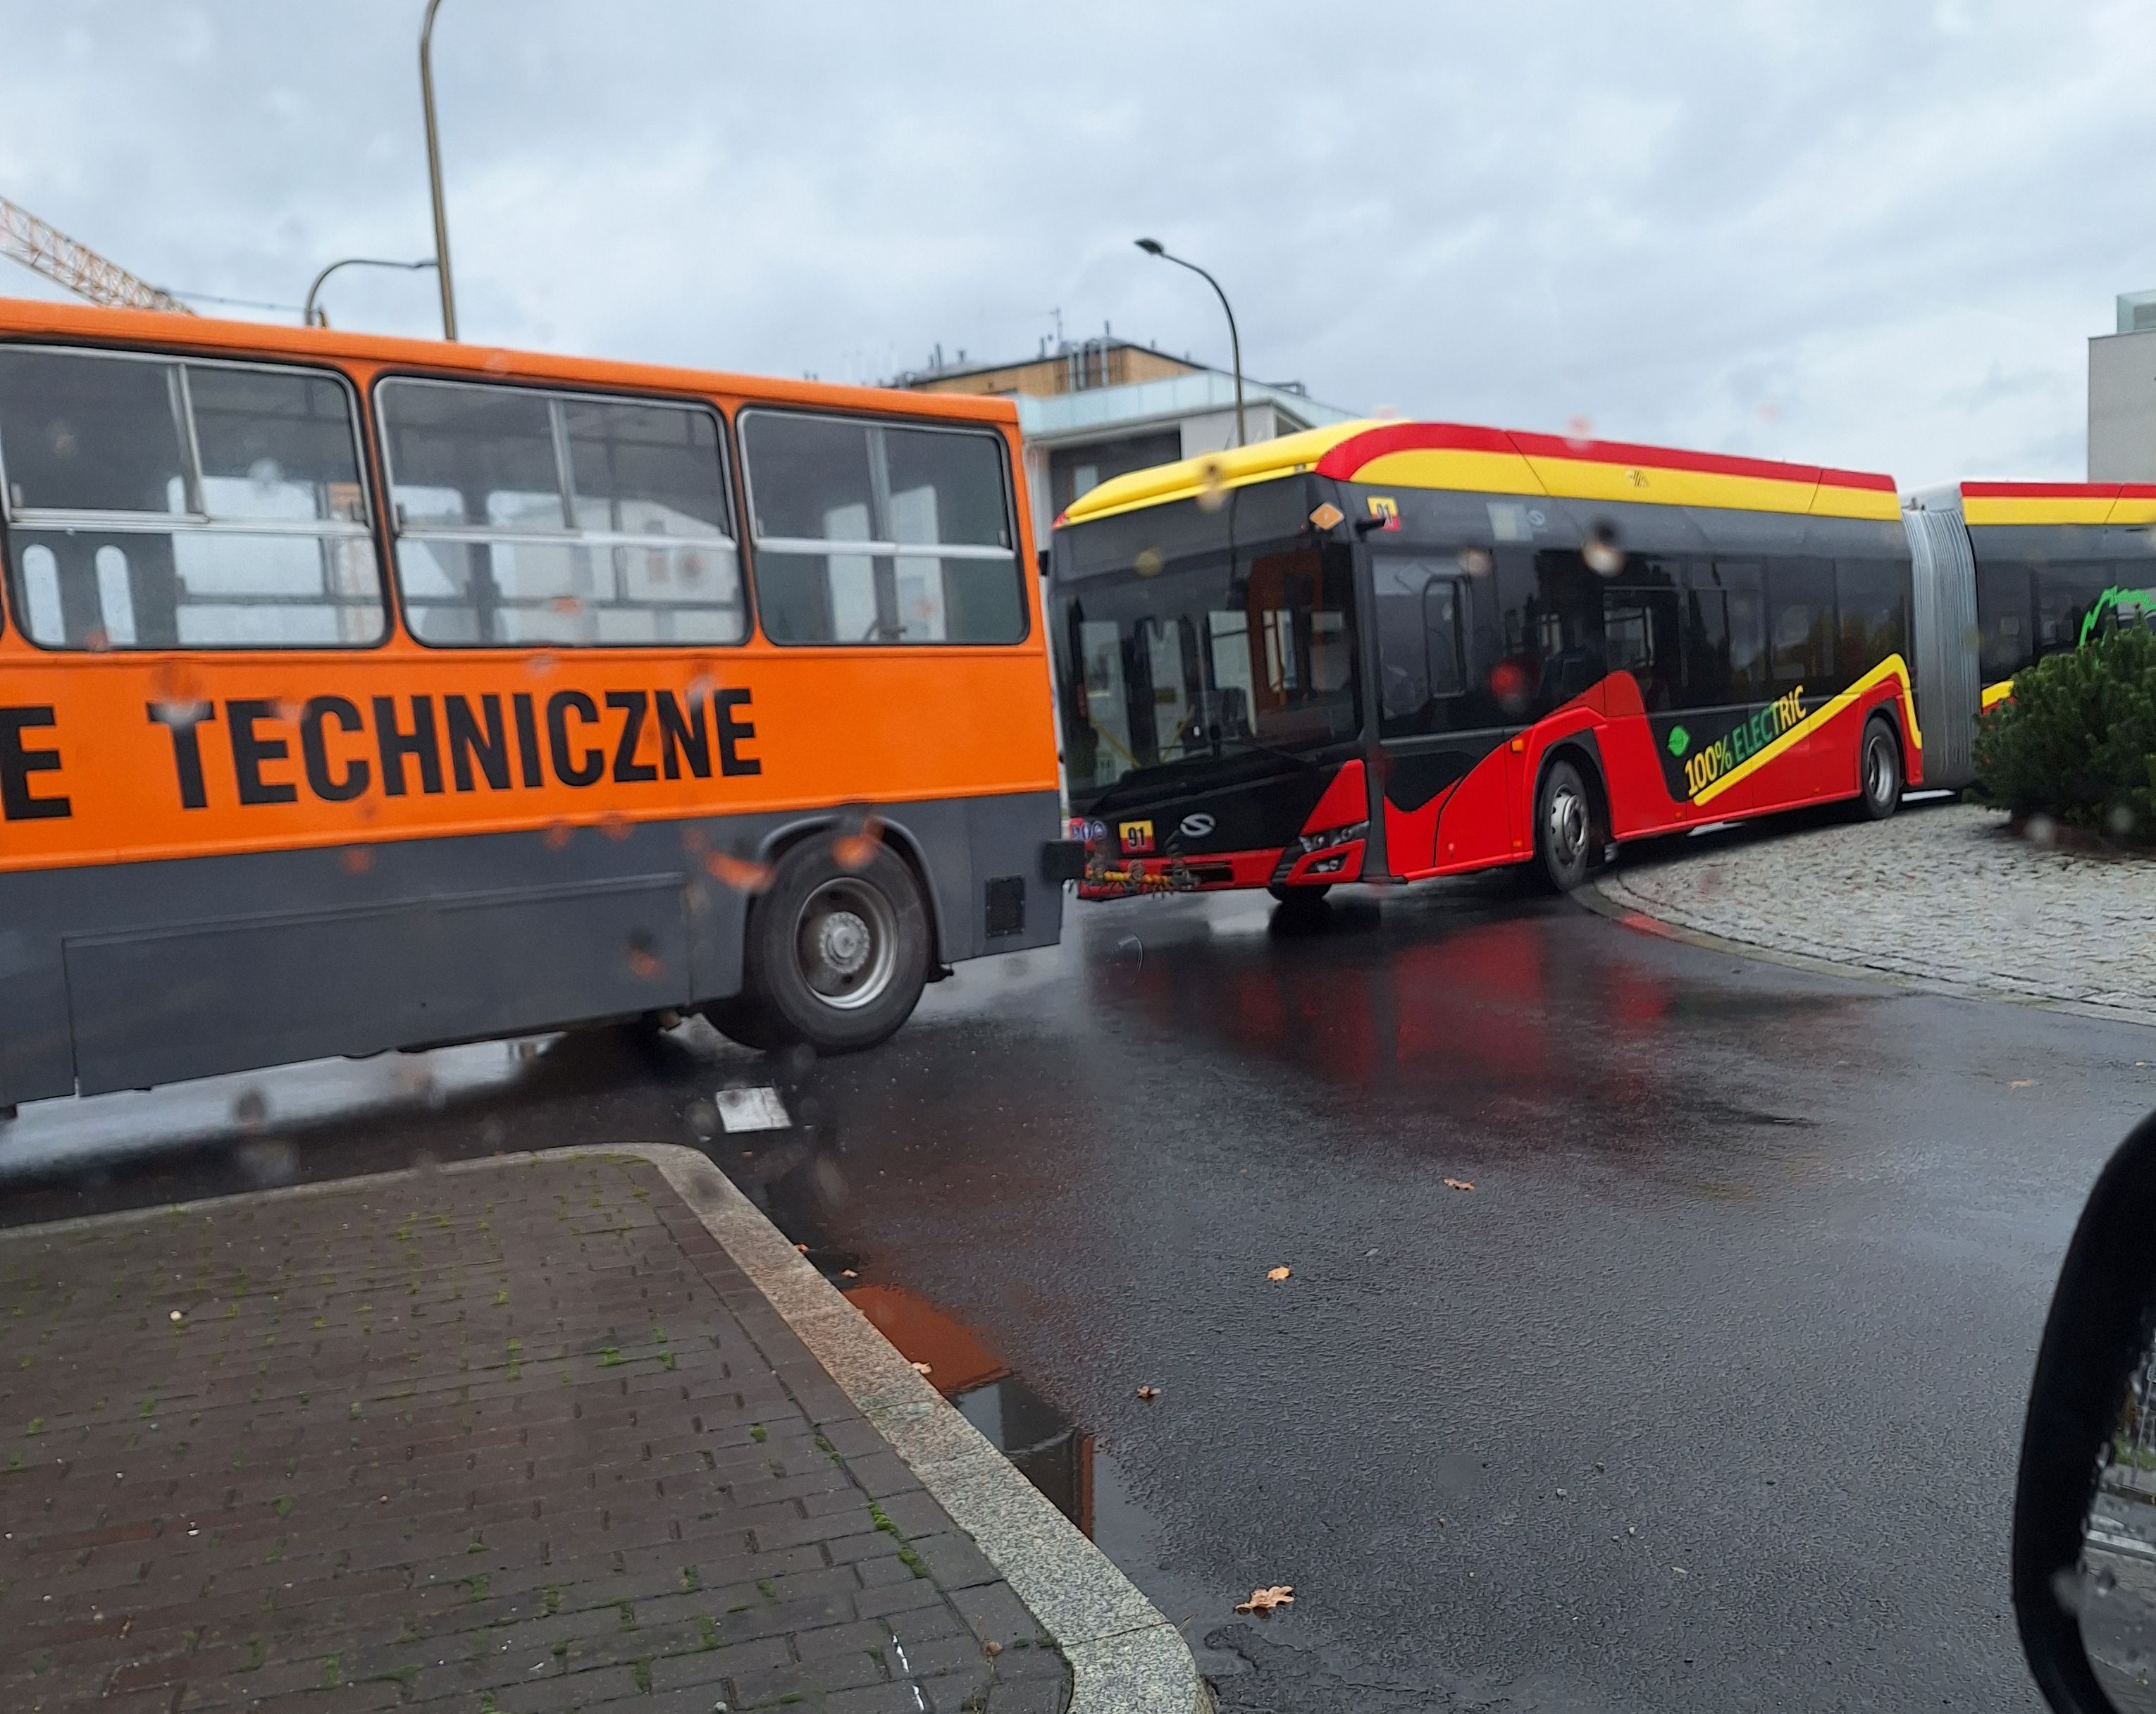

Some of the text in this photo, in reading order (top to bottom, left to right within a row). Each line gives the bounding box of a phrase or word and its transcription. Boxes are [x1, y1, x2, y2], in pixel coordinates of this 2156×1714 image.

[146, 688, 762, 809] TECHNICZNE
[1685, 684, 1807, 797] 100% ELECTRIC
[1127, 827, 1145, 848] 91
